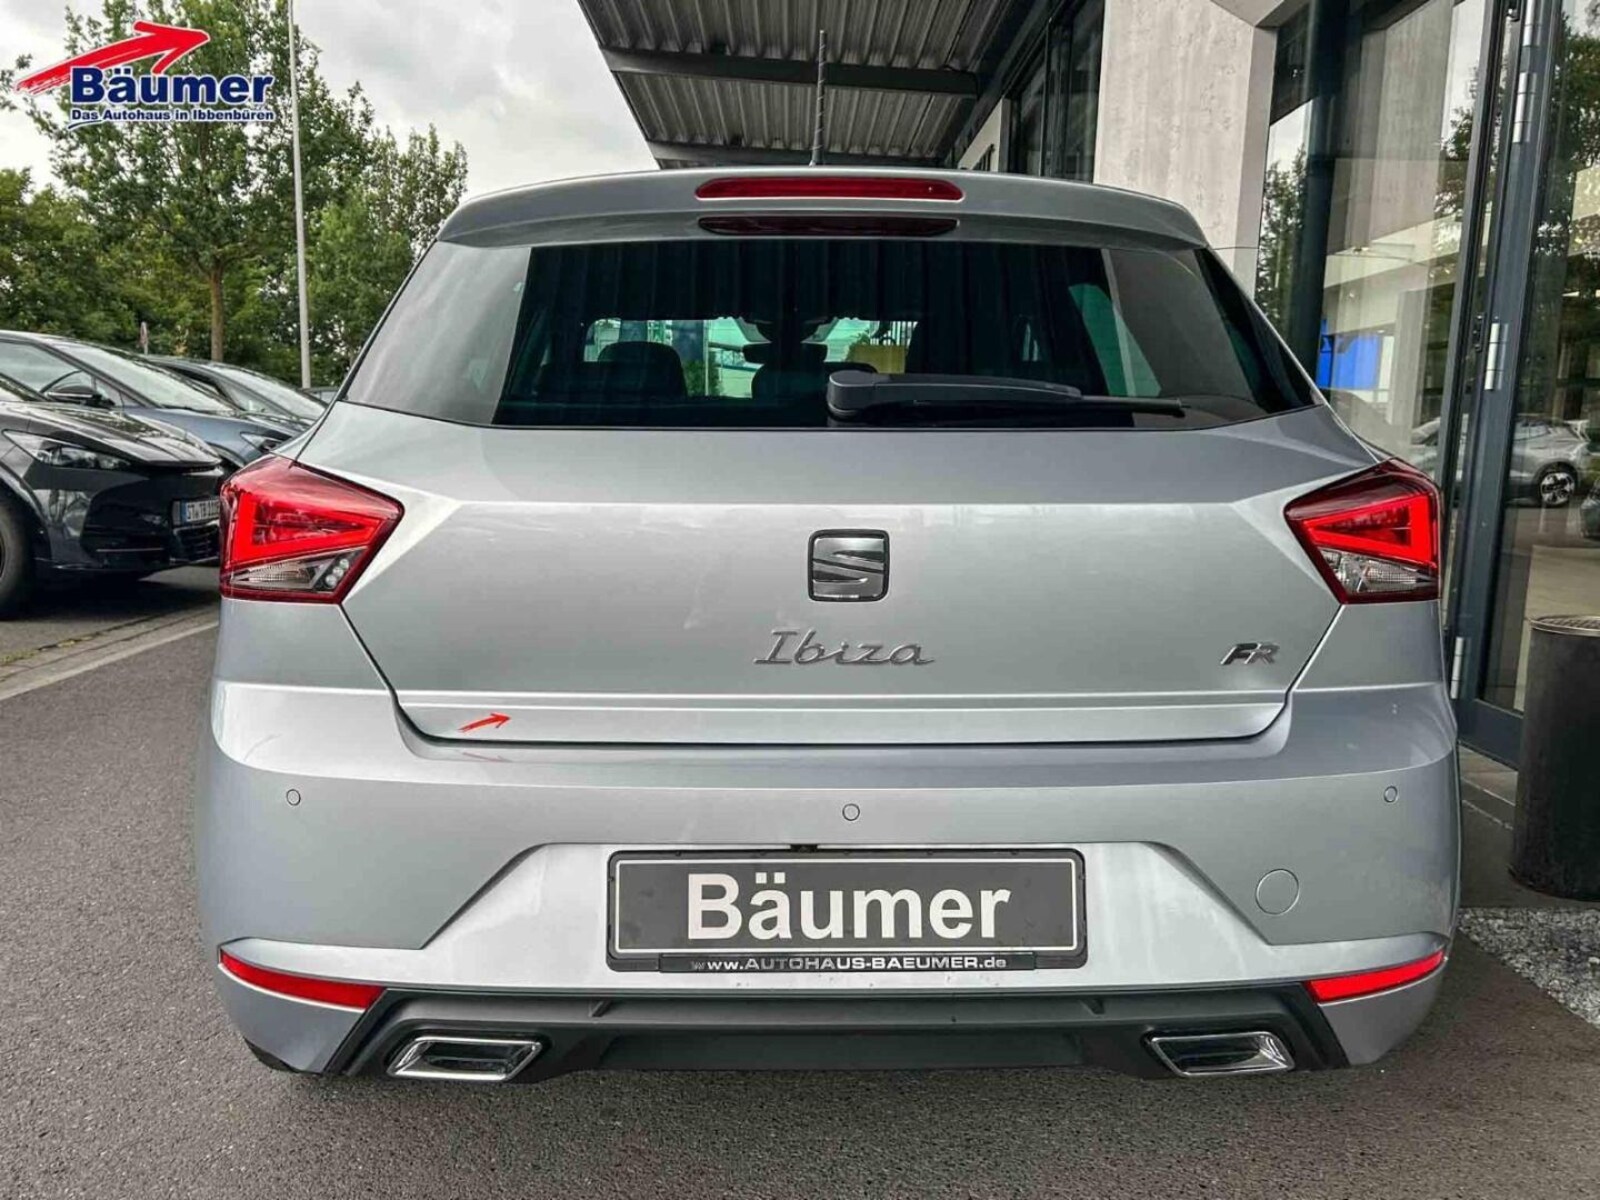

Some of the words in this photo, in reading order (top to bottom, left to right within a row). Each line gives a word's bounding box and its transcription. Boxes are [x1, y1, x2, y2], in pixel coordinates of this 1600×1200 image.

[752, 627, 935, 666] Ibiza
[1220, 642, 1280, 665] FR
[687, 871, 1012, 940] Bäumer
